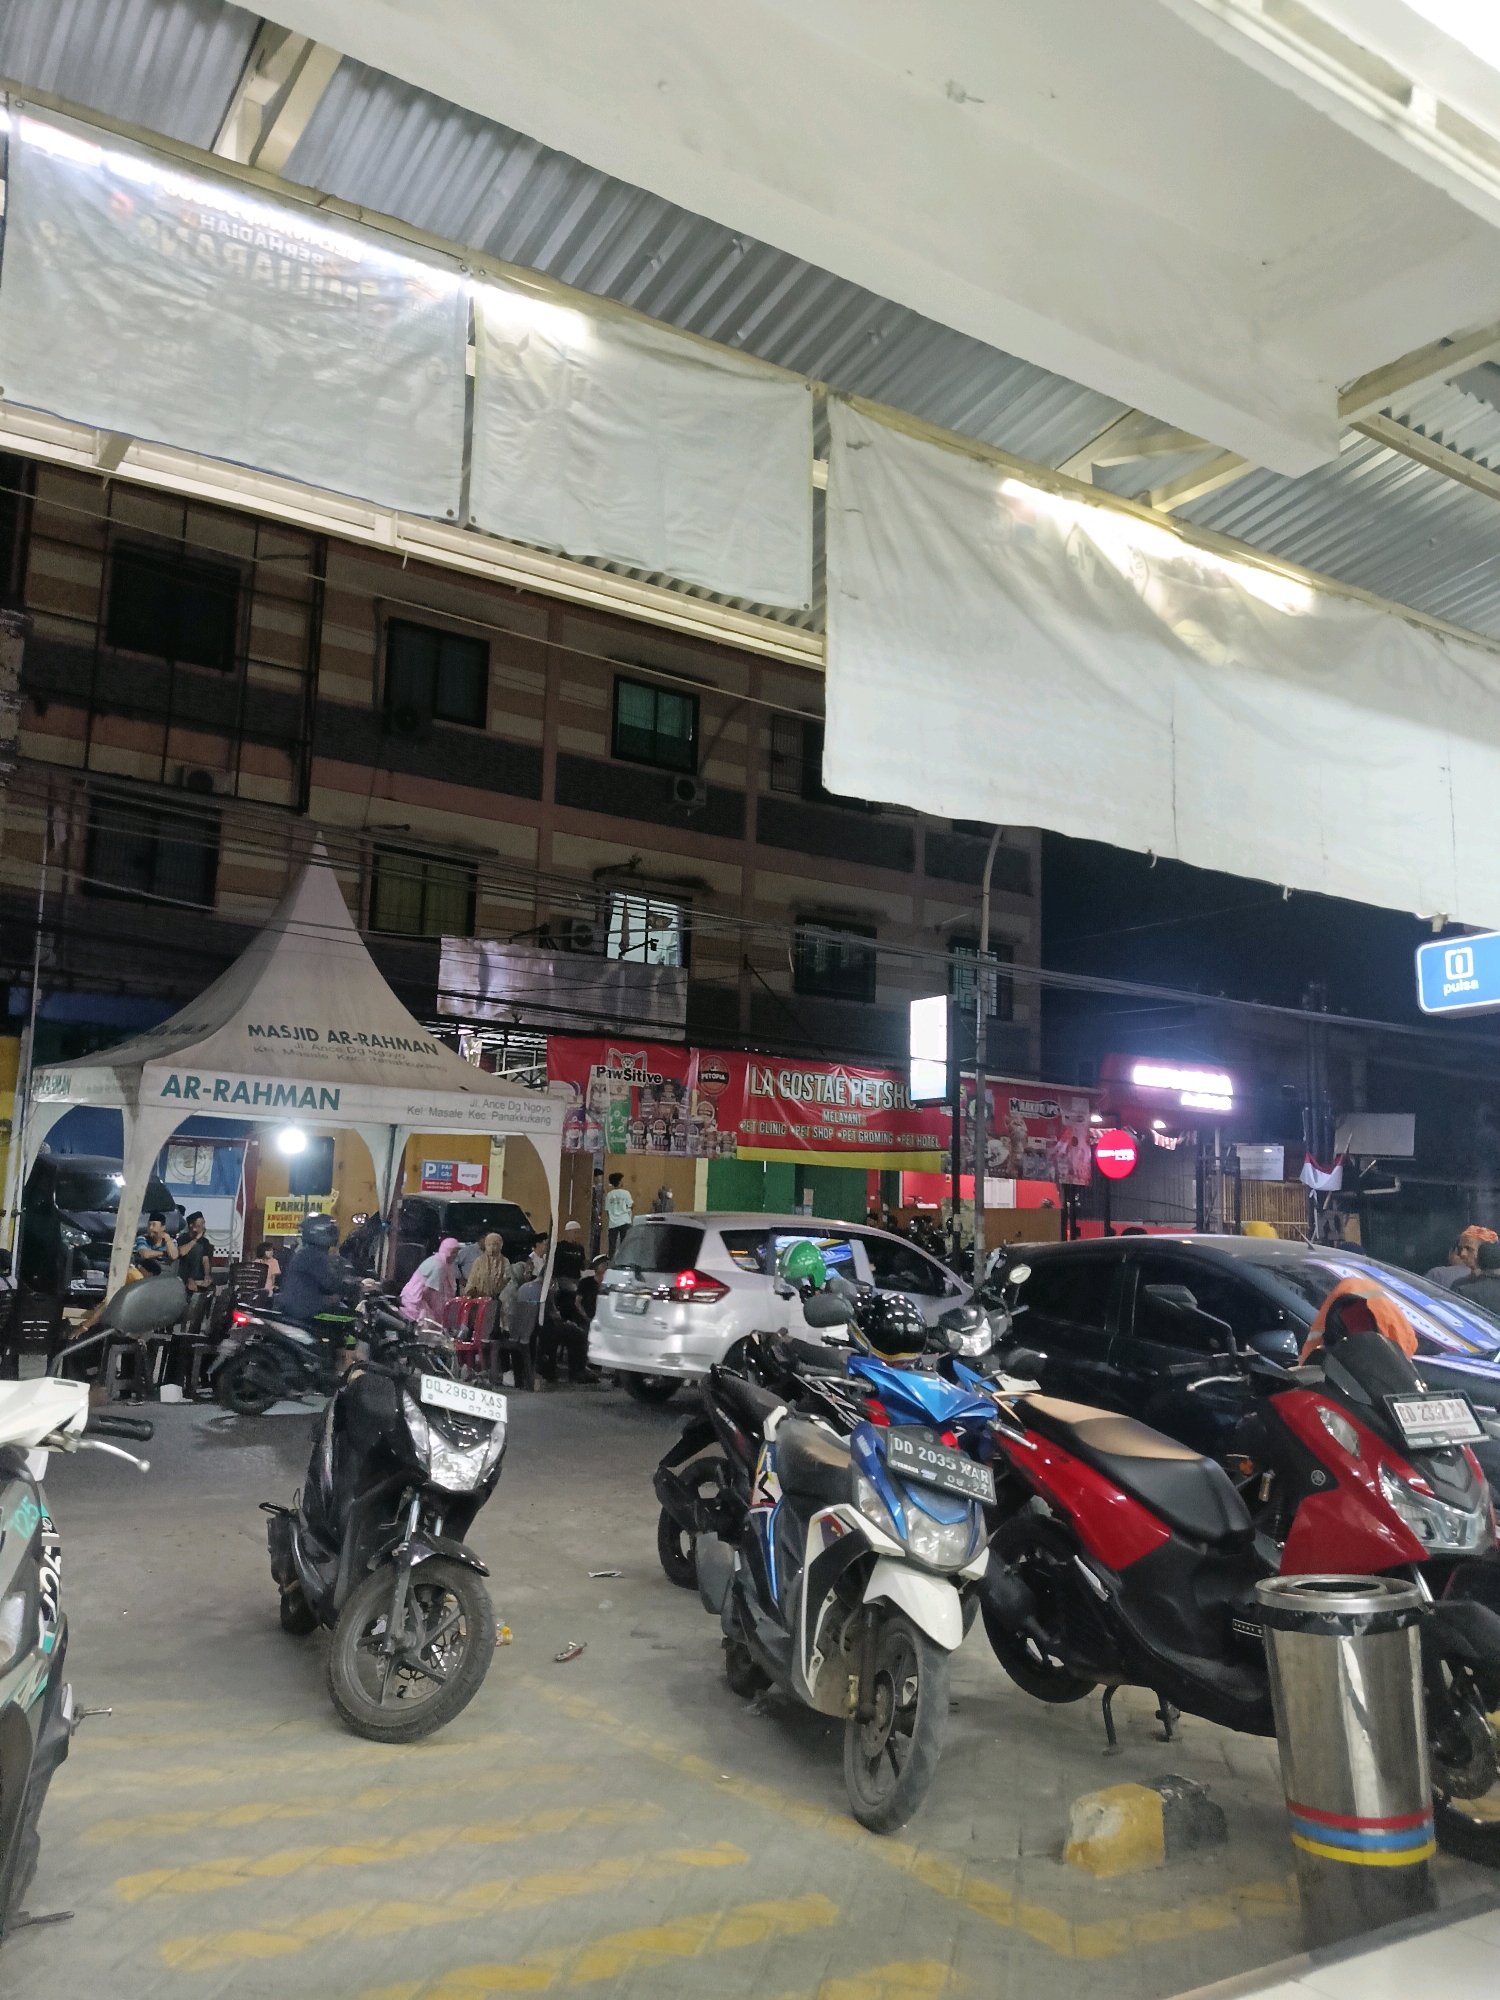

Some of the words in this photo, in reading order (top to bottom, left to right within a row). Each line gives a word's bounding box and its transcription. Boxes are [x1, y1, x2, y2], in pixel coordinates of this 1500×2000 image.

[1443, 979, 1479, 996] pulsa
[248, 1024, 319, 1042] MASJID
[327, 1030, 440, 1056] AR-RAHMAN
[283, 1049, 329, 1060] Masale
[346, 1046, 366, 1057] Dg
[370, 1048, 406, 1060] Ngoyo
[596, 1066, 662, 1084] PawSitive
[160, 1074, 341, 1110] AR-RAHMAN
[751, 1065, 773, 1097] LA
[779, 1070, 846, 1104] COSTAE
[850, 1077, 918, 1110] PETSHO
[482, 1099, 506, 1110] Ance
[508, 1100, 521, 1112] Dg
[523, 1102, 551, 1113] Ngoyo
[429, 1107, 463, 1119] Masale
[491, 1111, 551, 1126] Panakkukang
[822, 1111, 861, 1124] MELAYANI
[743, 1120, 756, 1132] PET
[759, 1121, 787, 1135] CLINIC
[795, 1125, 811, 1137] PET
[813, 1126, 834, 1139] SHOP
[842, 1129, 856, 1141] PET
[859, 1132, 893, 1144] GROMING
[901, 1135, 914, 1146] PET
[917, 1136, 940, 1148] HOTEL
[425, 1162, 437, 1178] P
[275, 1201, 323, 1212] PARKIAN
[446, 1384, 476, 1401] 2963
[481, 1393, 503, 1409] XAS
[894, 1437, 913, 1455] DD
[918, 1447, 957, 1470] 2035
[960, 1461, 989, 1484] XAR
